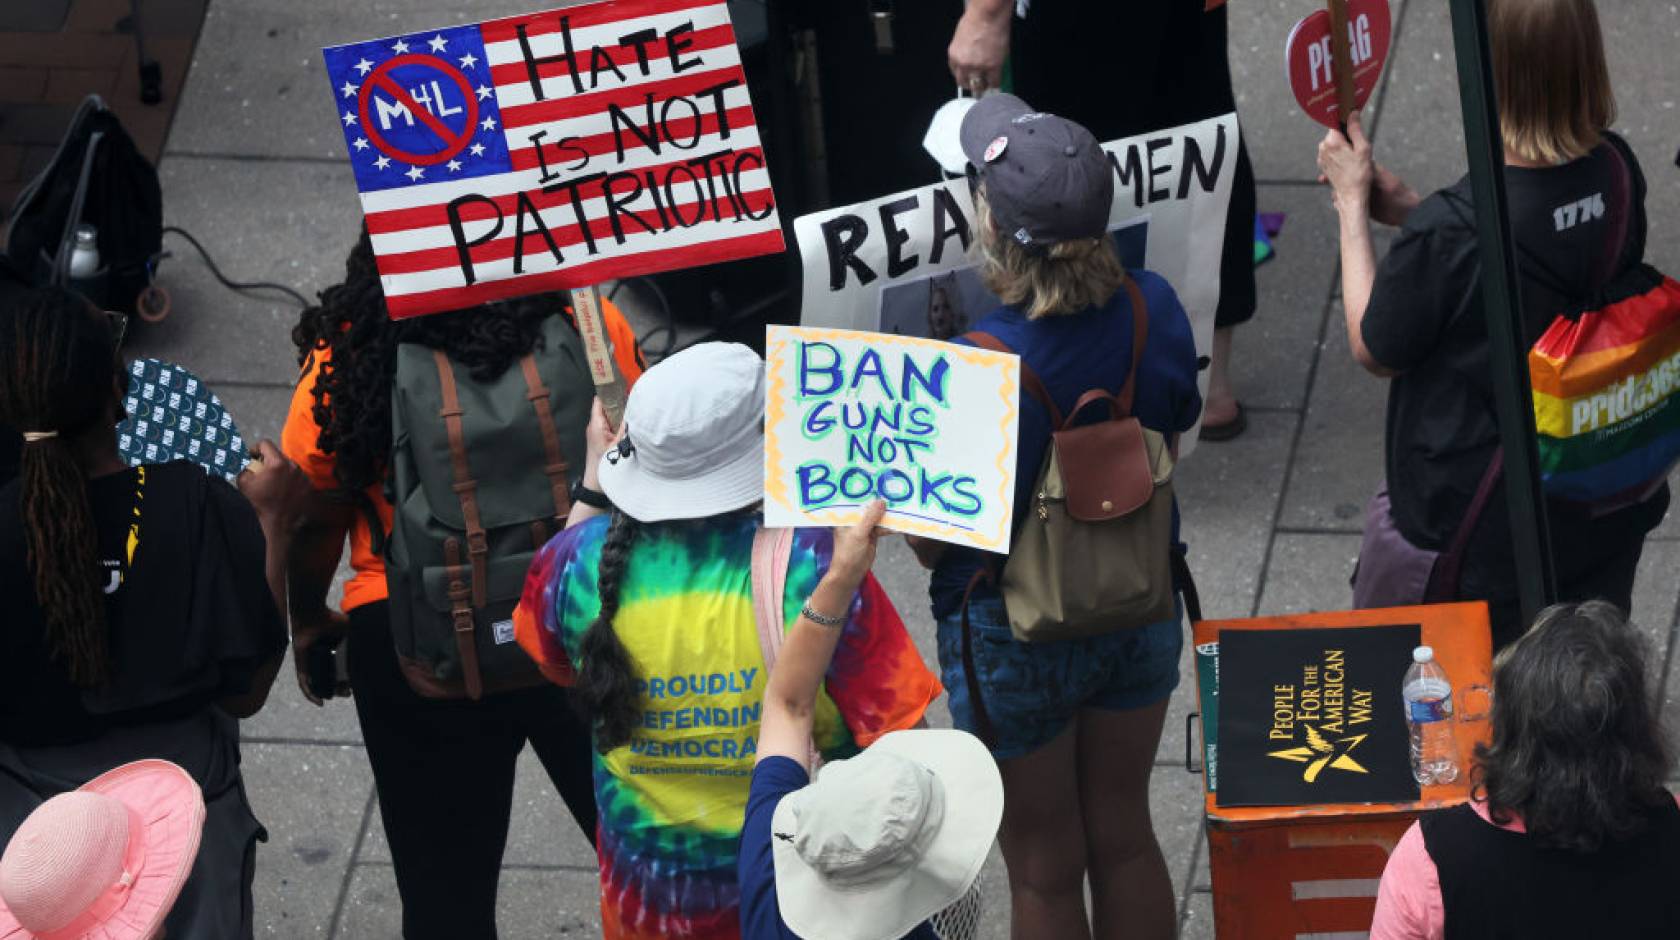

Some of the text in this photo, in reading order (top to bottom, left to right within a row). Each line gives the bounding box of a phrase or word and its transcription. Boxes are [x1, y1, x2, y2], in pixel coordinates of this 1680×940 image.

[516, 16, 704, 101] HATE
[1308, 14, 1373, 92] PFAG
[373, 80, 462, 131] M4L
[608, 80, 740, 163] NOT
[447, 149, 774, 287] PATRIOTIC
[821, 124, 1227, 292] REA MEN
[1553, 192, 1606, 231] 1776
[799, 340, 950, 403] BAN
[805, 400, 936, 436] GUNS
[849, 430, 931, 465] NOT
[796, 463, 983, 516] BOOKS
[630, 667, 758, 700] PROUDLY
[1295, 665, 1320, 721] FOR THE
[1320, 650, 1345, 734] AMERICAN
[1348, 688, 1373, 726] WAY
[638, 701, 762, 730] EFENDIN
[1269, 684, 1294, 740] PEOPLE
[629, 735, 757, 760] DEMOCRA
